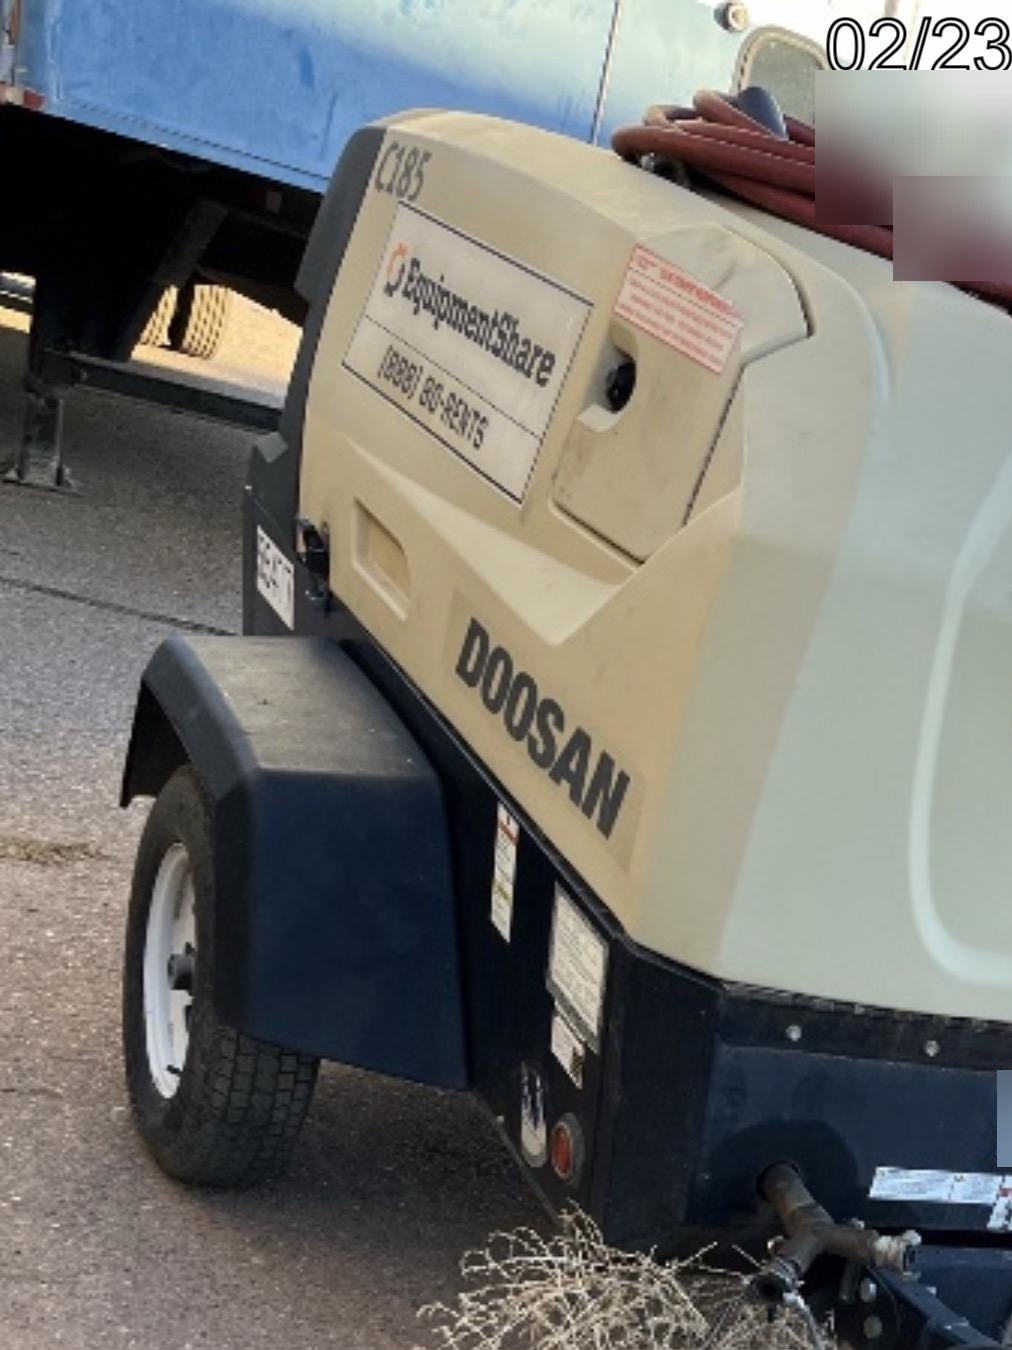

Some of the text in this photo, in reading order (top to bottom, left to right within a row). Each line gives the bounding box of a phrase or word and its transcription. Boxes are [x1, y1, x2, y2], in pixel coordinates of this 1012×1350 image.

[374, 141, 432, 201] C185
[401, 257, 556, 387] EquipmentShare
[456, 617, 631, 840] DOOSAN
